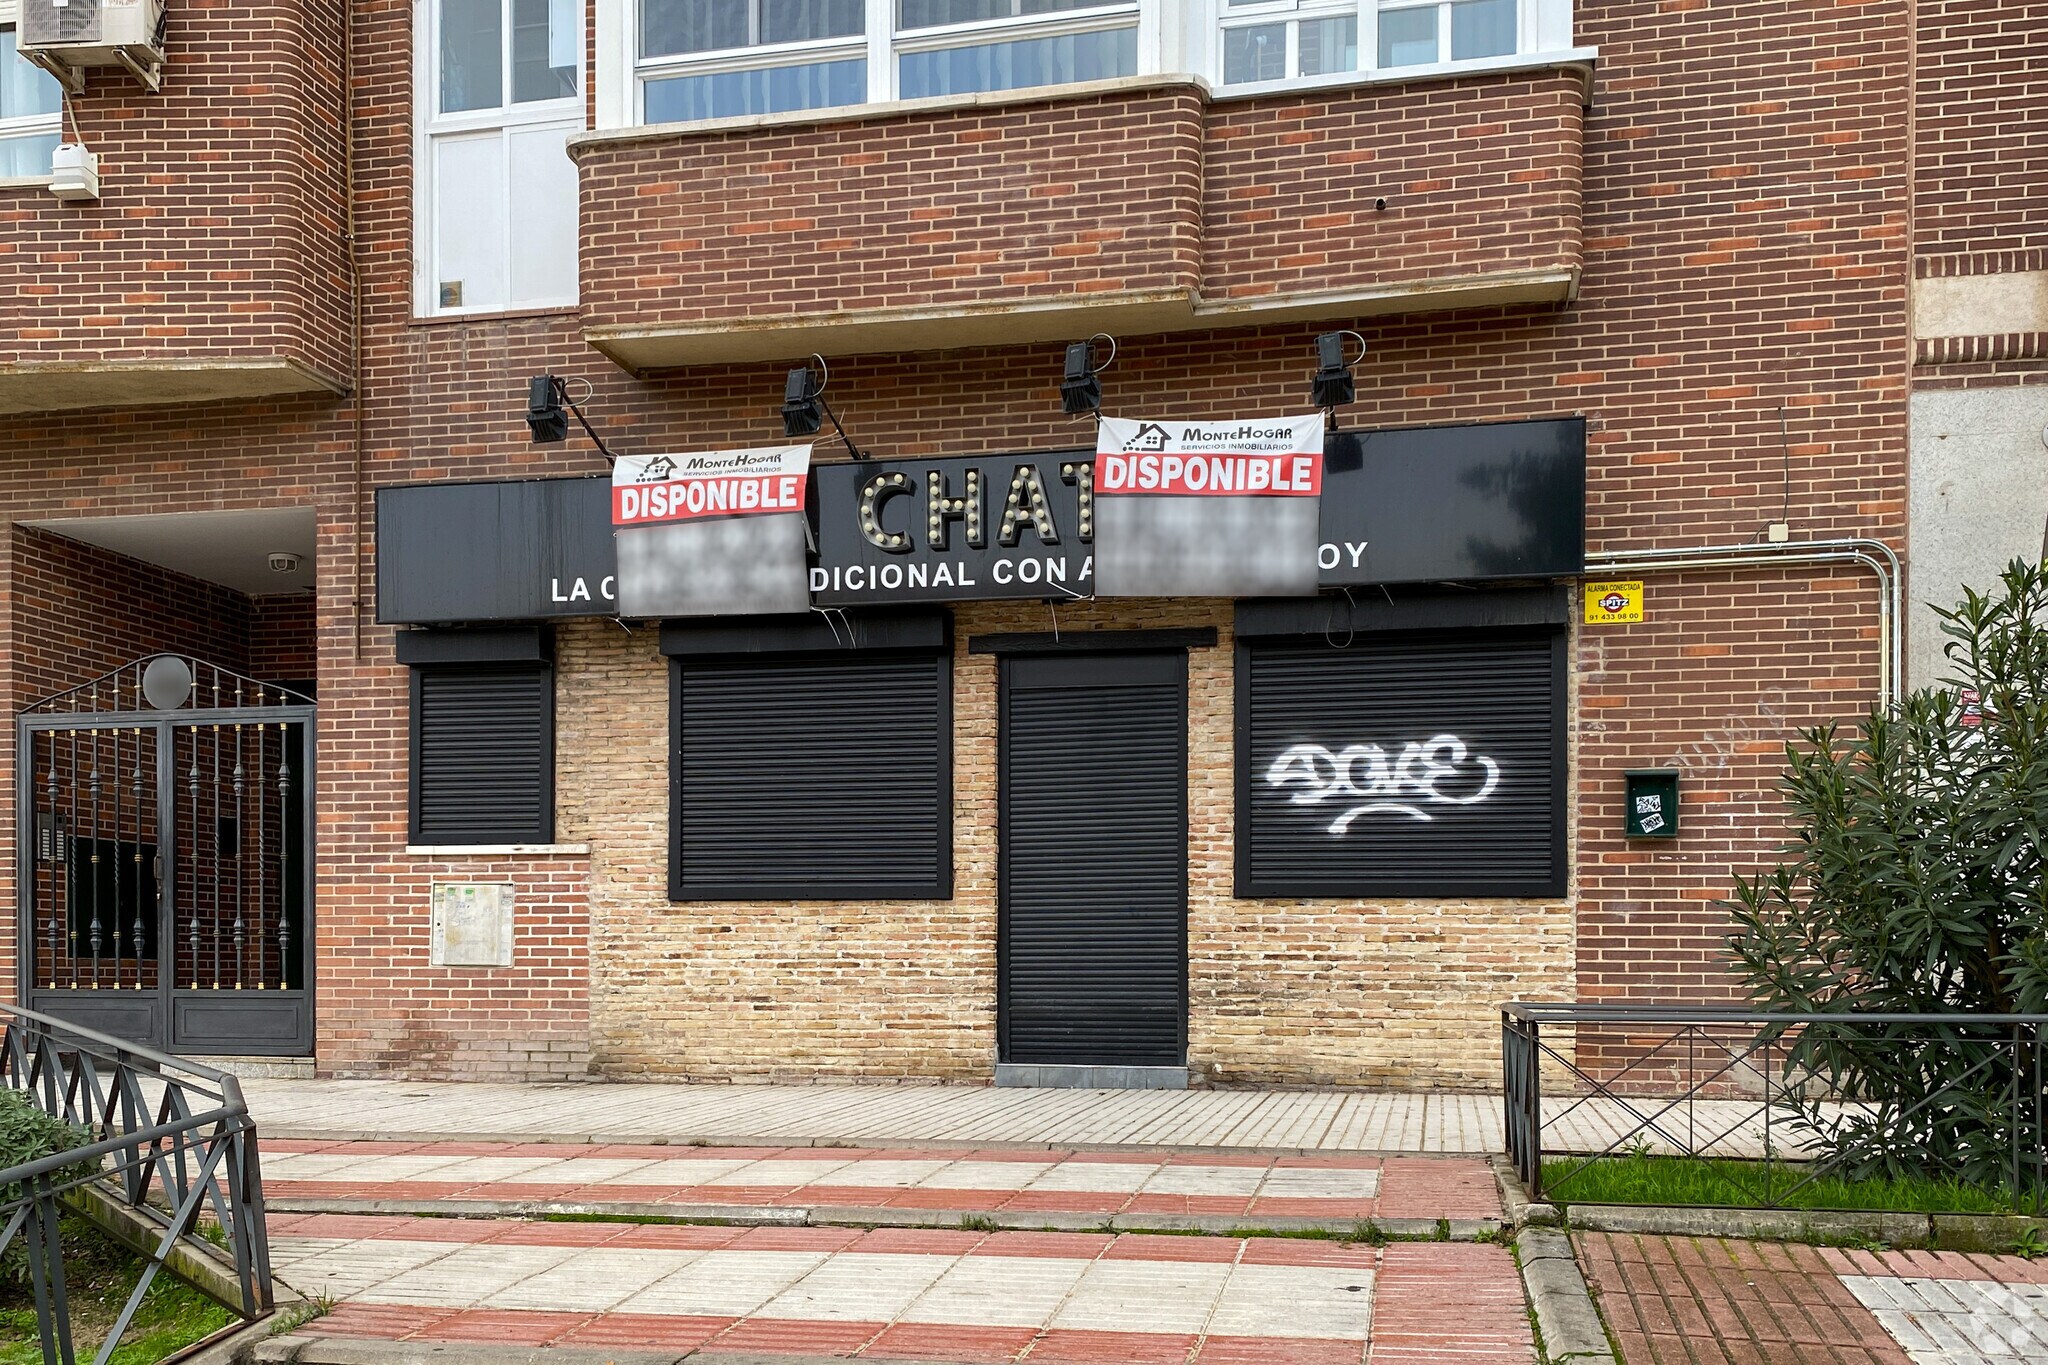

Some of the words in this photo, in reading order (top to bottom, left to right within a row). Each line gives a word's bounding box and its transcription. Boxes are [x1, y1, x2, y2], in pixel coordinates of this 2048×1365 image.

[1228, 442, 1294, 451] INMOBILIARIOS
[1103, 455, 1313, 492] DISPONIBLE
[621, 477, 798, 520] DISPONIBLE
[552, 577, 591, 601] LA
[992, 557, 1067, 585] CON
[1610, 584, 1641, 592] CONECTADA
[1600, 599, 1629, 607] SPITZ
